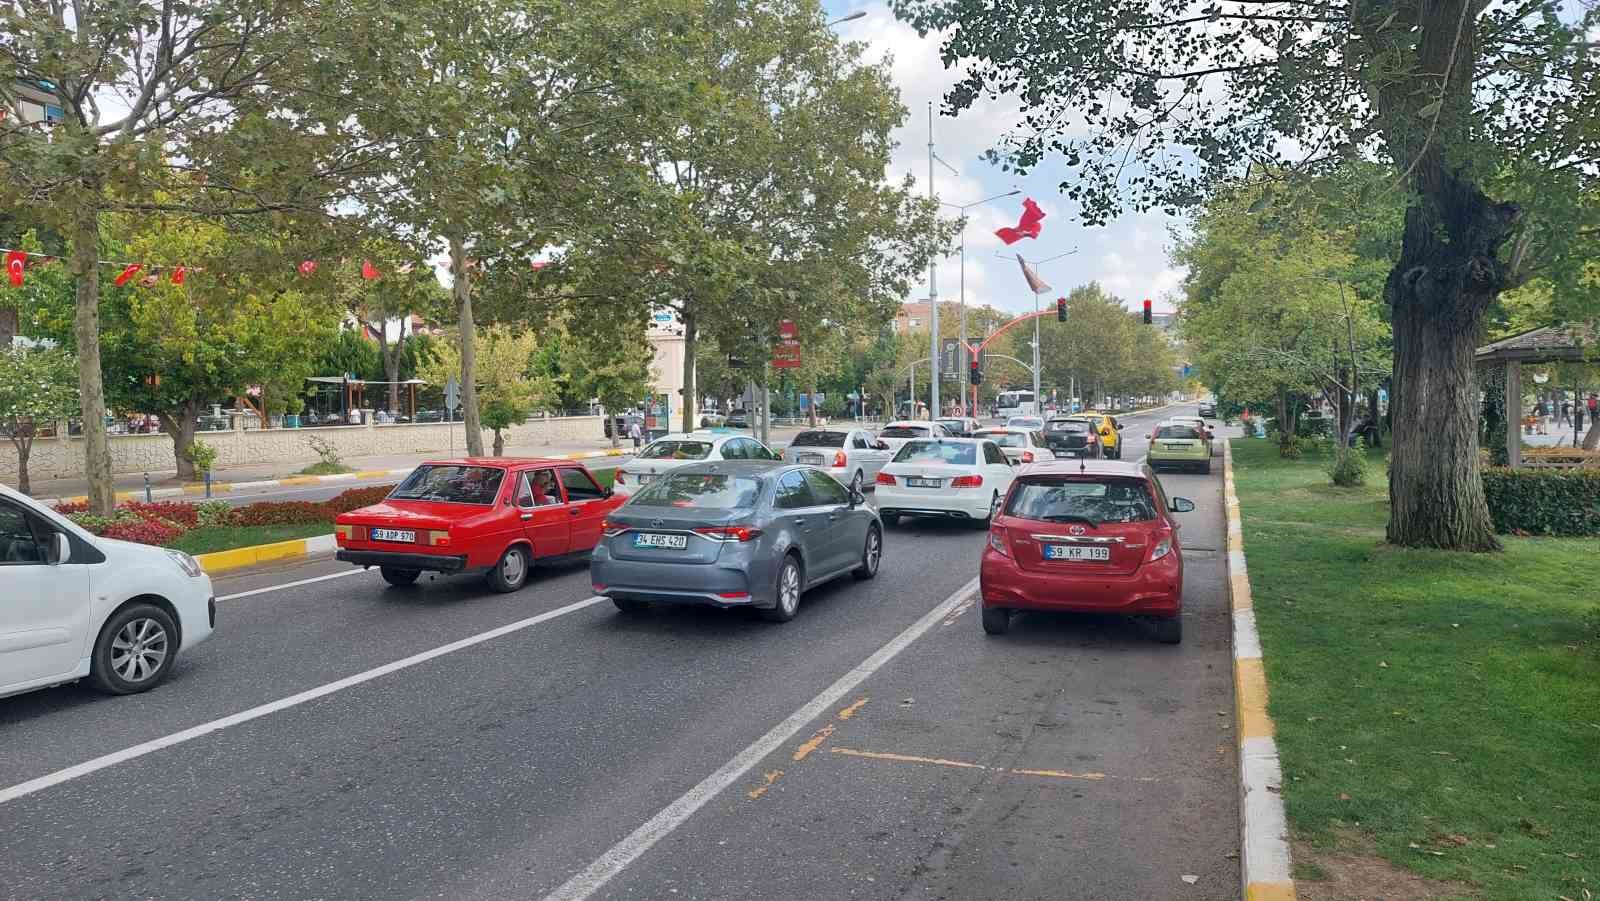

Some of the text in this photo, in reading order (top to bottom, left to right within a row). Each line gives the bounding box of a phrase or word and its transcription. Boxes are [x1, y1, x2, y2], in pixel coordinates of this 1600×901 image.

[638, 534, 648, 544] 34
[669, 536, 684, 546] 420
[1051, 547, 1108, 558] 59 KR 199
